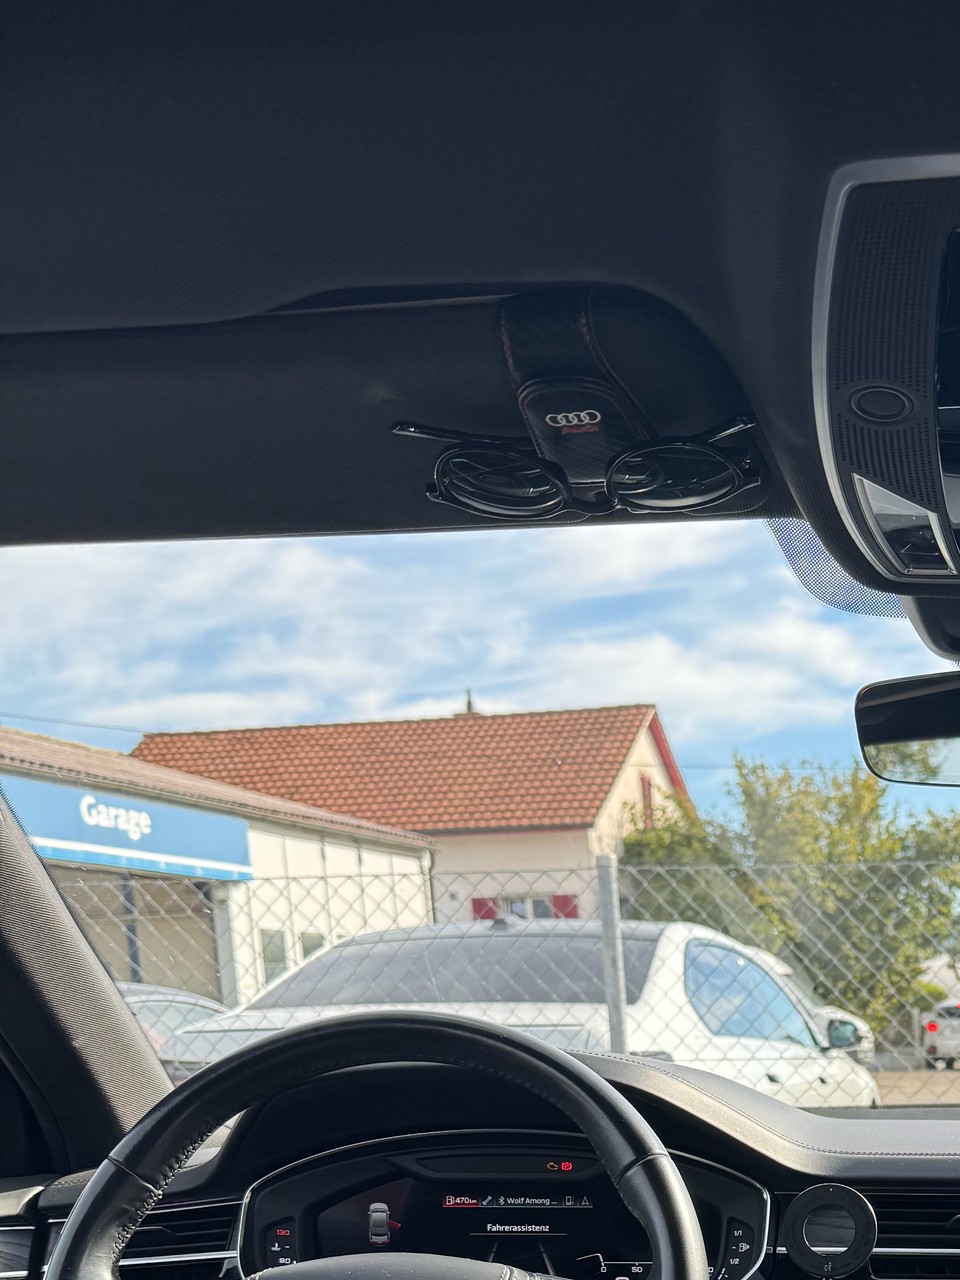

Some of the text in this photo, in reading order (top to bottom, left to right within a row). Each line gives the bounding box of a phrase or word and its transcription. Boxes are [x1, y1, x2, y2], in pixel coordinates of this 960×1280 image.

[80, 795, 151, 840] Garage
[506, 1196, 524, 1205] Wolf
[525, 1197, 550, 1206] Among
[486, 1223, 550, 1233] Fahrerassistenz
